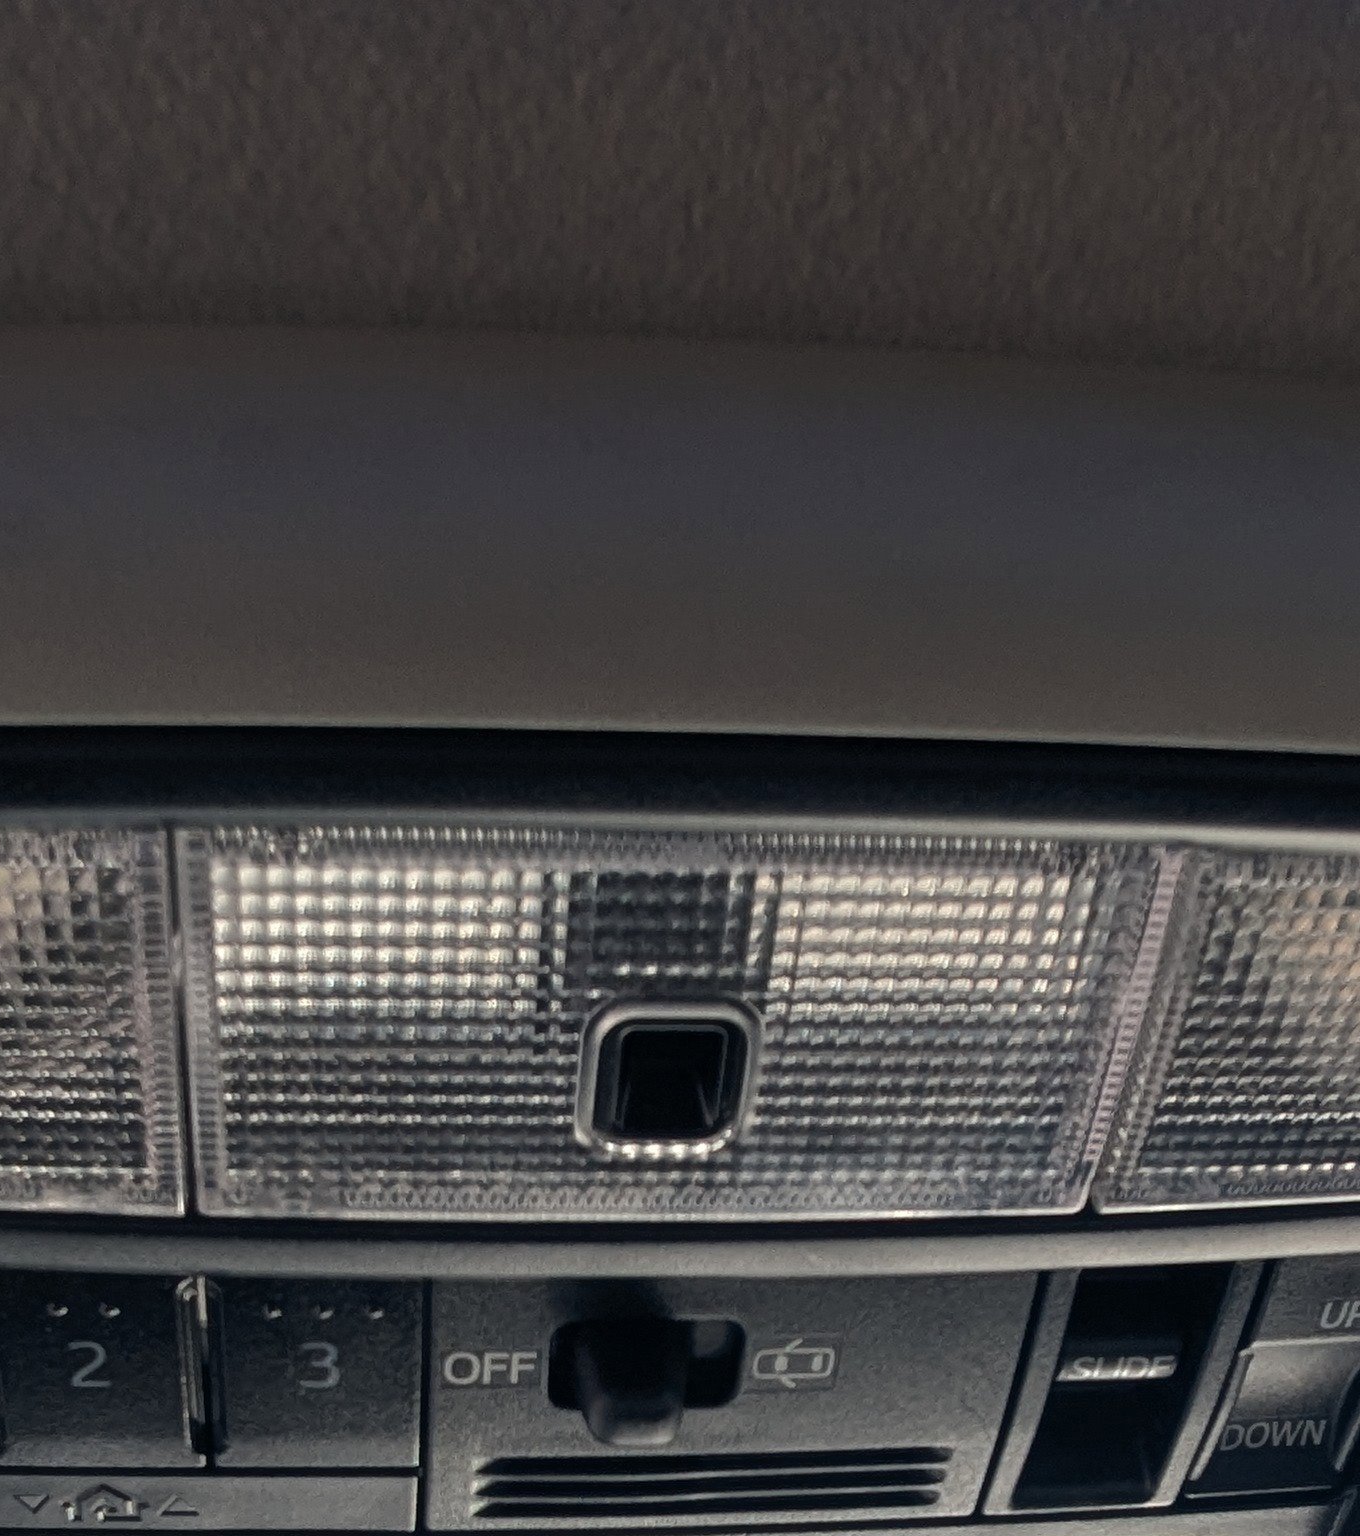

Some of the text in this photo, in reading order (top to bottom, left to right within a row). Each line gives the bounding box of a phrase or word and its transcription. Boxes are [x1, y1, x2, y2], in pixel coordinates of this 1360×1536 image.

[68, 1341, 111, 1388] 2
[298, 1342, 340, 1389] 3
[444, 1351, 538, 1385] OFF
[1219, 1419, 1327, 1451] DOWN
